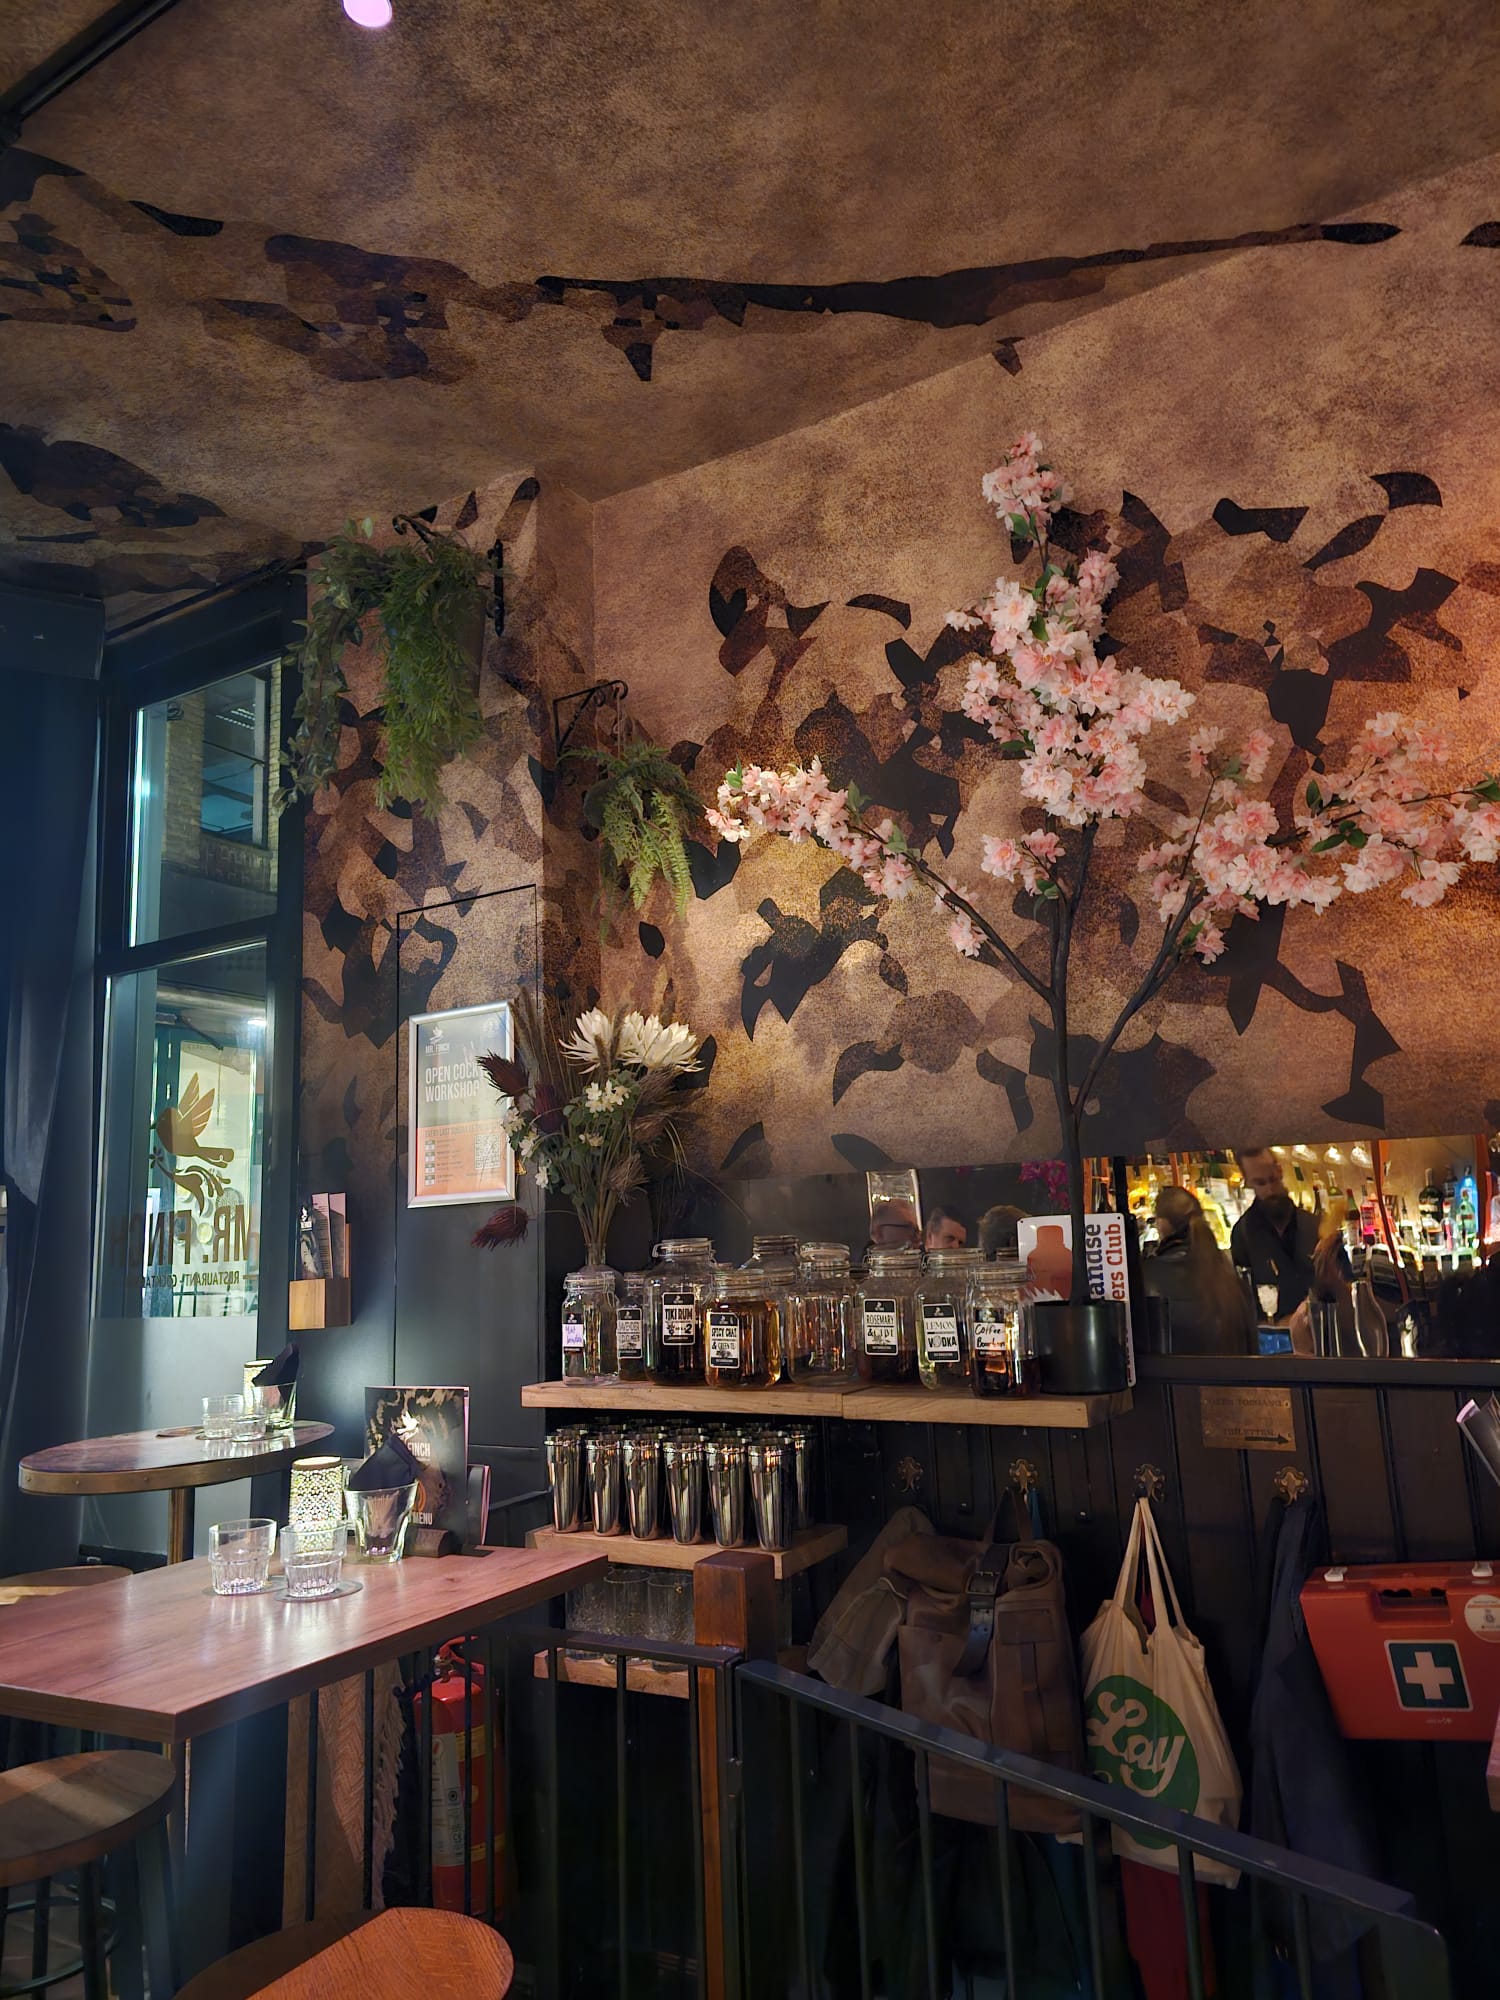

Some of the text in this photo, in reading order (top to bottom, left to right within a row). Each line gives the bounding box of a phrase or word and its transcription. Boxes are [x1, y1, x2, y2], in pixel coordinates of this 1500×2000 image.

[425, 1061, 480, 1084] OPEN COCK
[425, 1080, 480, 1103] WORKSHOP
[1104, 1223, 1123, 1266] Club
[1086, 1224, 1105, 1300] andse
[664, 1308, 693, 1320] TIKI RUM
[866, 1313, 894, 1325] ROSEMARY
[925, 1321, 955, 1331] LEMON
[974, 1323, 1002, 1336] Coffee
[711, 1328, 725, 1338] SPICY
[927, 1335, 958, 1348] VODKA
[407, 1442, 431, 1457] FINCH
